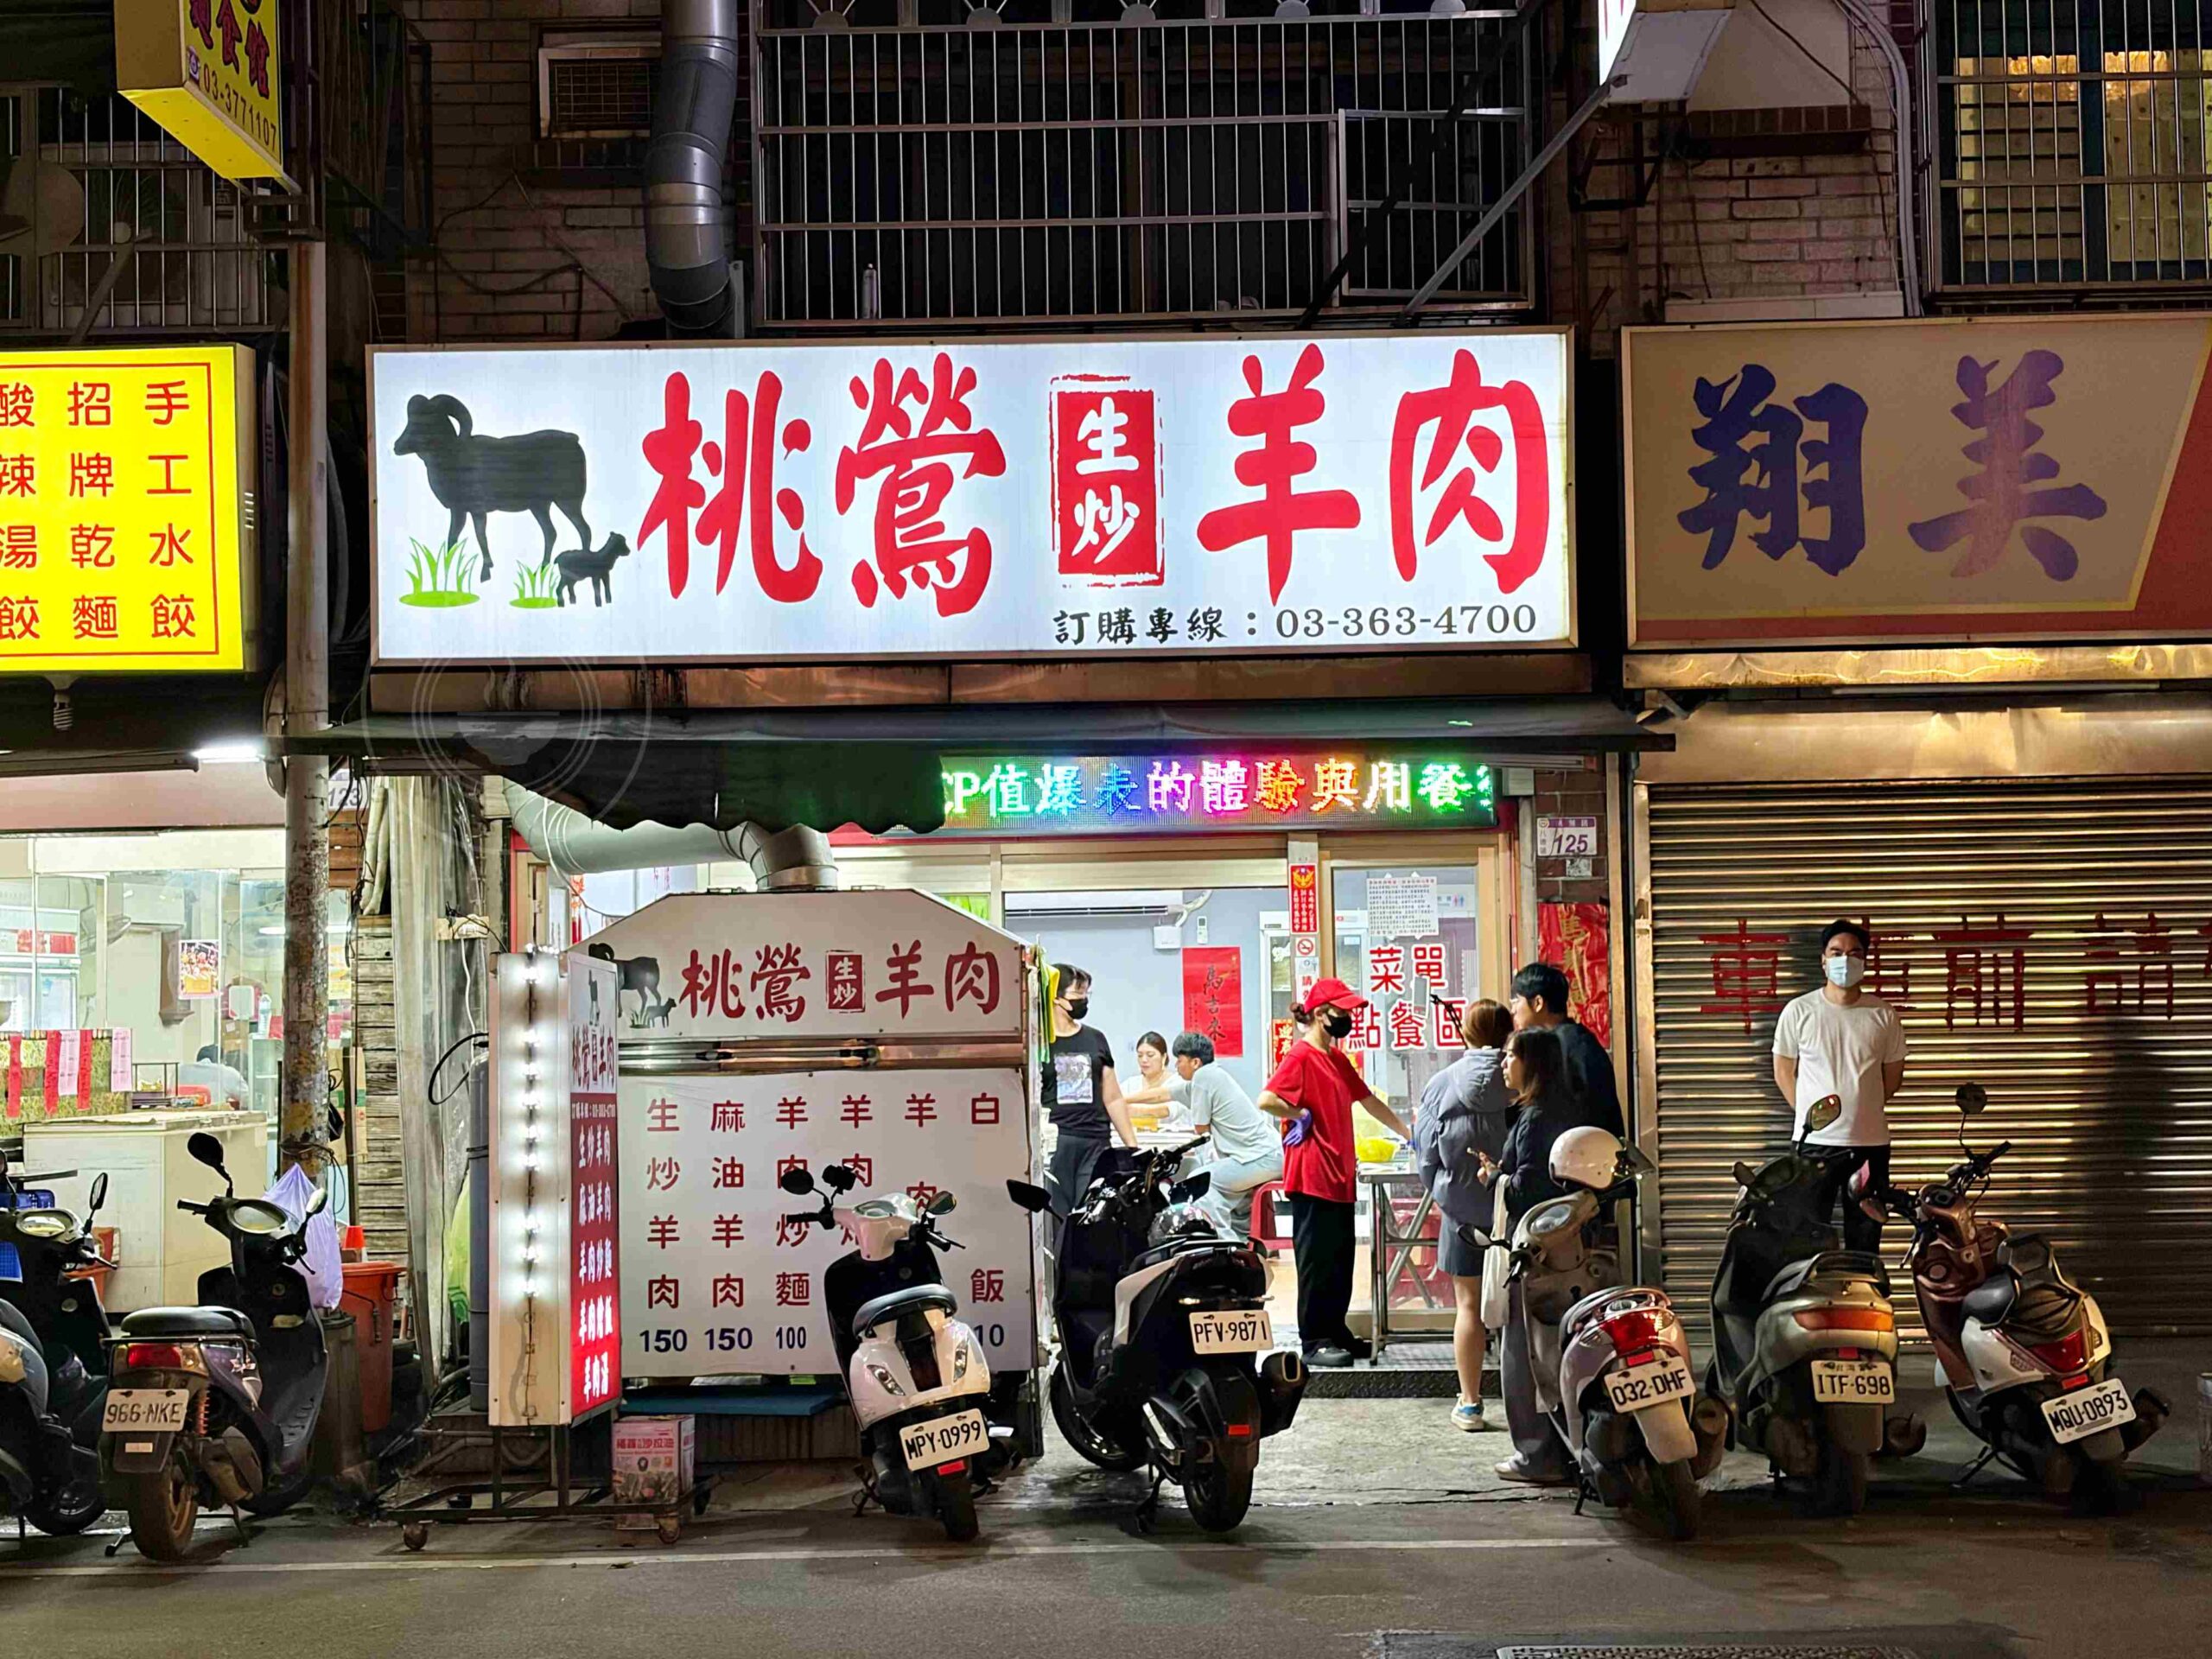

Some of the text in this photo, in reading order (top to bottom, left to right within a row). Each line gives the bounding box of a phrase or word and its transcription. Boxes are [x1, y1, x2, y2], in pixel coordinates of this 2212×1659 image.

[203, 63, 276, 152] 03-3771107
[637, 343, 1549, 617] 桃鶯 生炒 羊肉
[1676, 348, 2108, 582] 翔美
[67, 381, 118, 639] 招牌乾麵
[144, 380, 195, 639] 手工水餃
[1275, 604, 1537, 639] 03-363-4700
[1554, 834, 1588, 854] 125
[833, 957, 857, 1006] 生炒
[875, 939, 1000, 1020] 羊肉
[1370, 946, 1446, 993] 菜單
[1349, 1000, 1467, 1051] 點餐區
[646, 1097, 681, 1310] 生炒羊肉
[710, 1099, 746, 1308] 麻油羊肉
[639, 1328, 688, 1353] 150
[704, 1327, 753, 1351] 150
[775, 1326, 807, 1350] 100
[1192, 1316, 1269, 1345] PFV-9871
[1611, 1368, 1687, 1406] 032-DHF
[1816, 1374, 1891, 1395] ITF-698
[106, 1402, 183, 1424] 966-NKE
[2047, 1389, 2128, 1433] MQU-0893
[905, 1421, 981, 1459] MPY-0999
